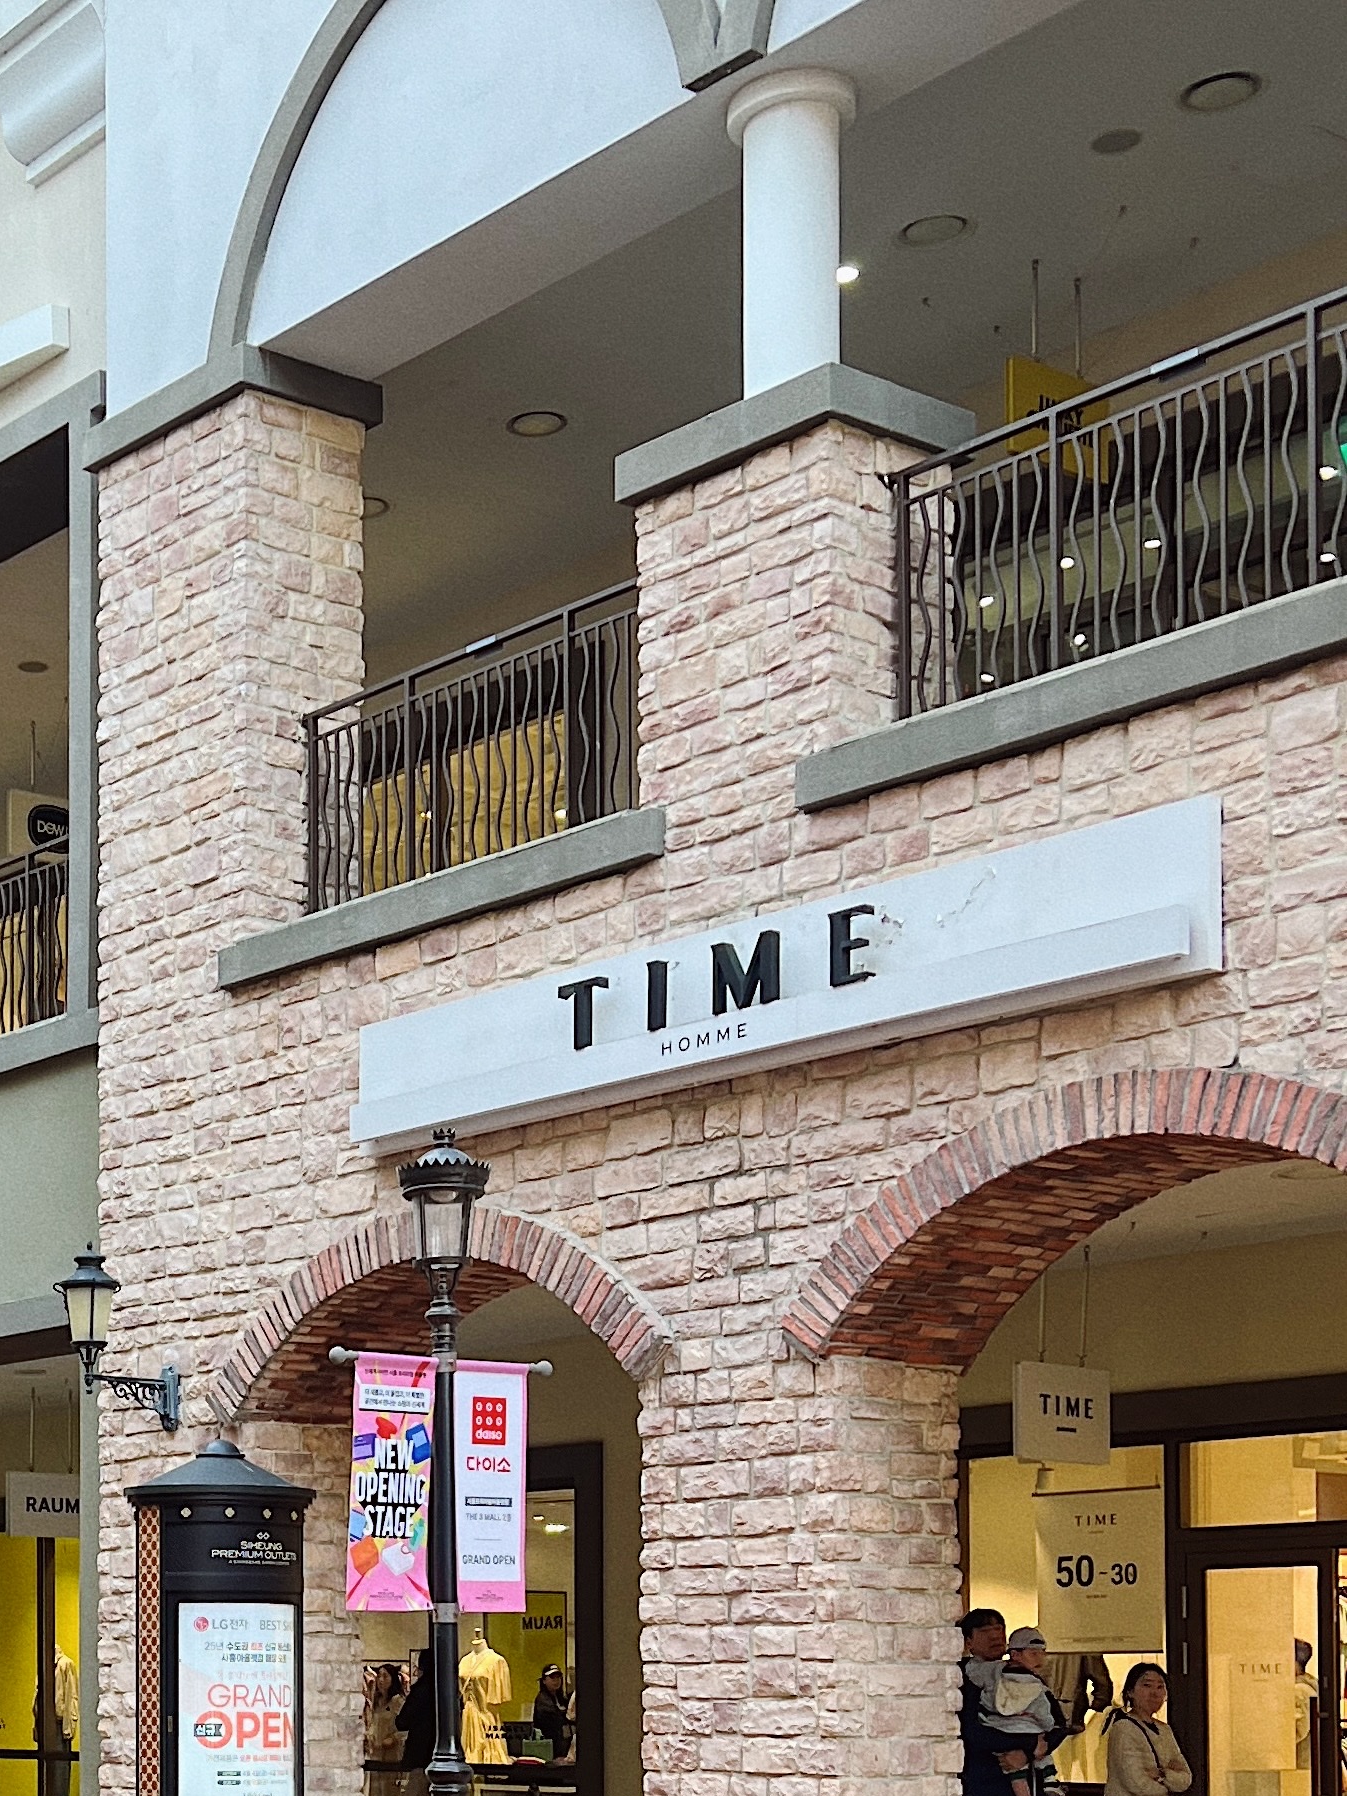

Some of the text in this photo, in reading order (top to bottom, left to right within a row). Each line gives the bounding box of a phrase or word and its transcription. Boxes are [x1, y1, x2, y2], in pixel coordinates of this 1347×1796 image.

[557, 904, 876, 1051] TIME
[661, 1023, 747, 1056] HOMME
[1039, 1393, 1094, 1420] TIME
[475, 1428, 502, 1440] daiso
[374, 1437, 414, 1470] NEW
[466, 1456, 511, 1473] 다이소
[355, 1471, 427, 1505] OPENING
[26, 1496, 80, 1514] RAUM
[363, 1505, 415, 1538] STAGE
[1075, 1513, 1118, 1527] TIME
[240, 1540, 283, 1550] SIHEUNG
[211, 1549, 297, 1561] PREMIUM OUTLETS
[462, 1554, 515, 1565] GRAND OPEN
[212, 1618, 248, 1631] LG전자
[259, 1619, 281, 1631] BEST
[1239, 1663, 1281, 1675] TIME
[207, 1683, 292, 1708] GRAND
[195, 1724, 216, 1736] 신규
